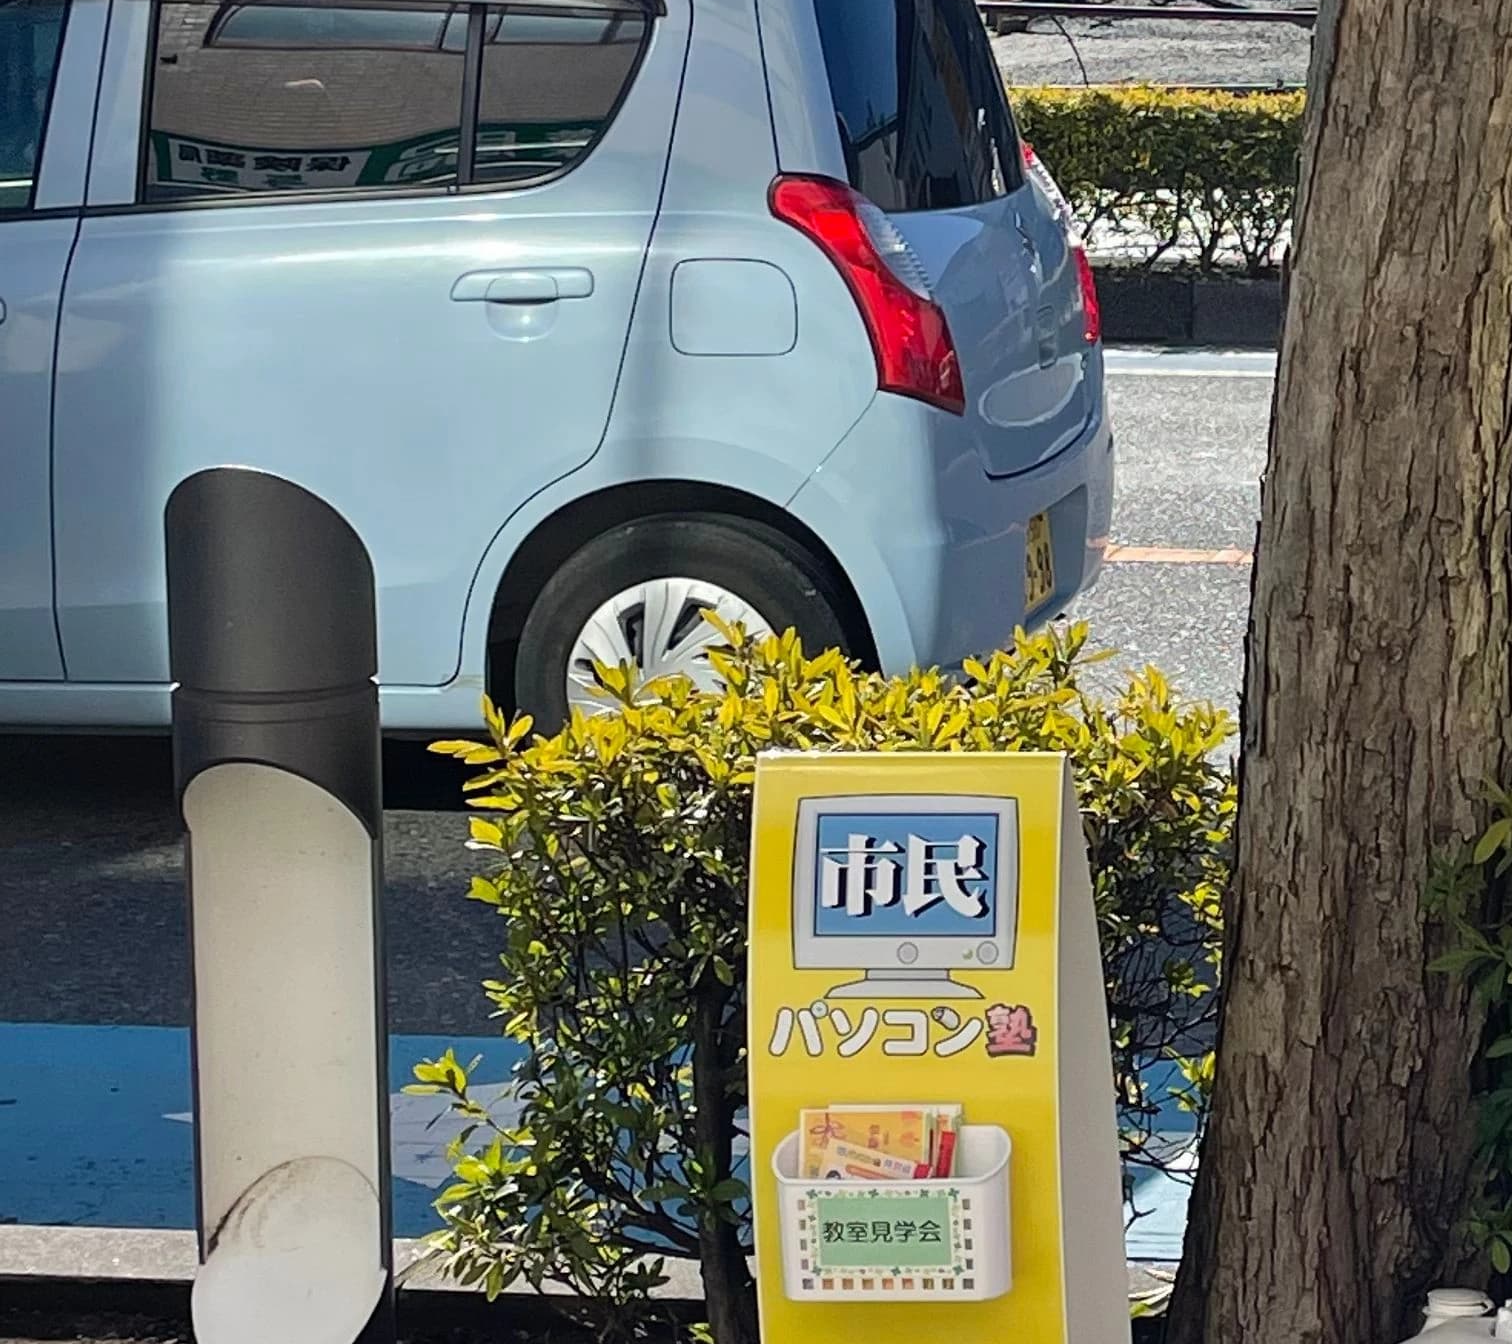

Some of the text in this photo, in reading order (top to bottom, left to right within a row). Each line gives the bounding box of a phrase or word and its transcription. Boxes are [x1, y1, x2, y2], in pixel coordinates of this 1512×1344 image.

[820, 833, 990, 919] 市民
[768, 998, 1038, 1058] パソコン塾
[823, 1219, 942, 1244] 教室見学会
